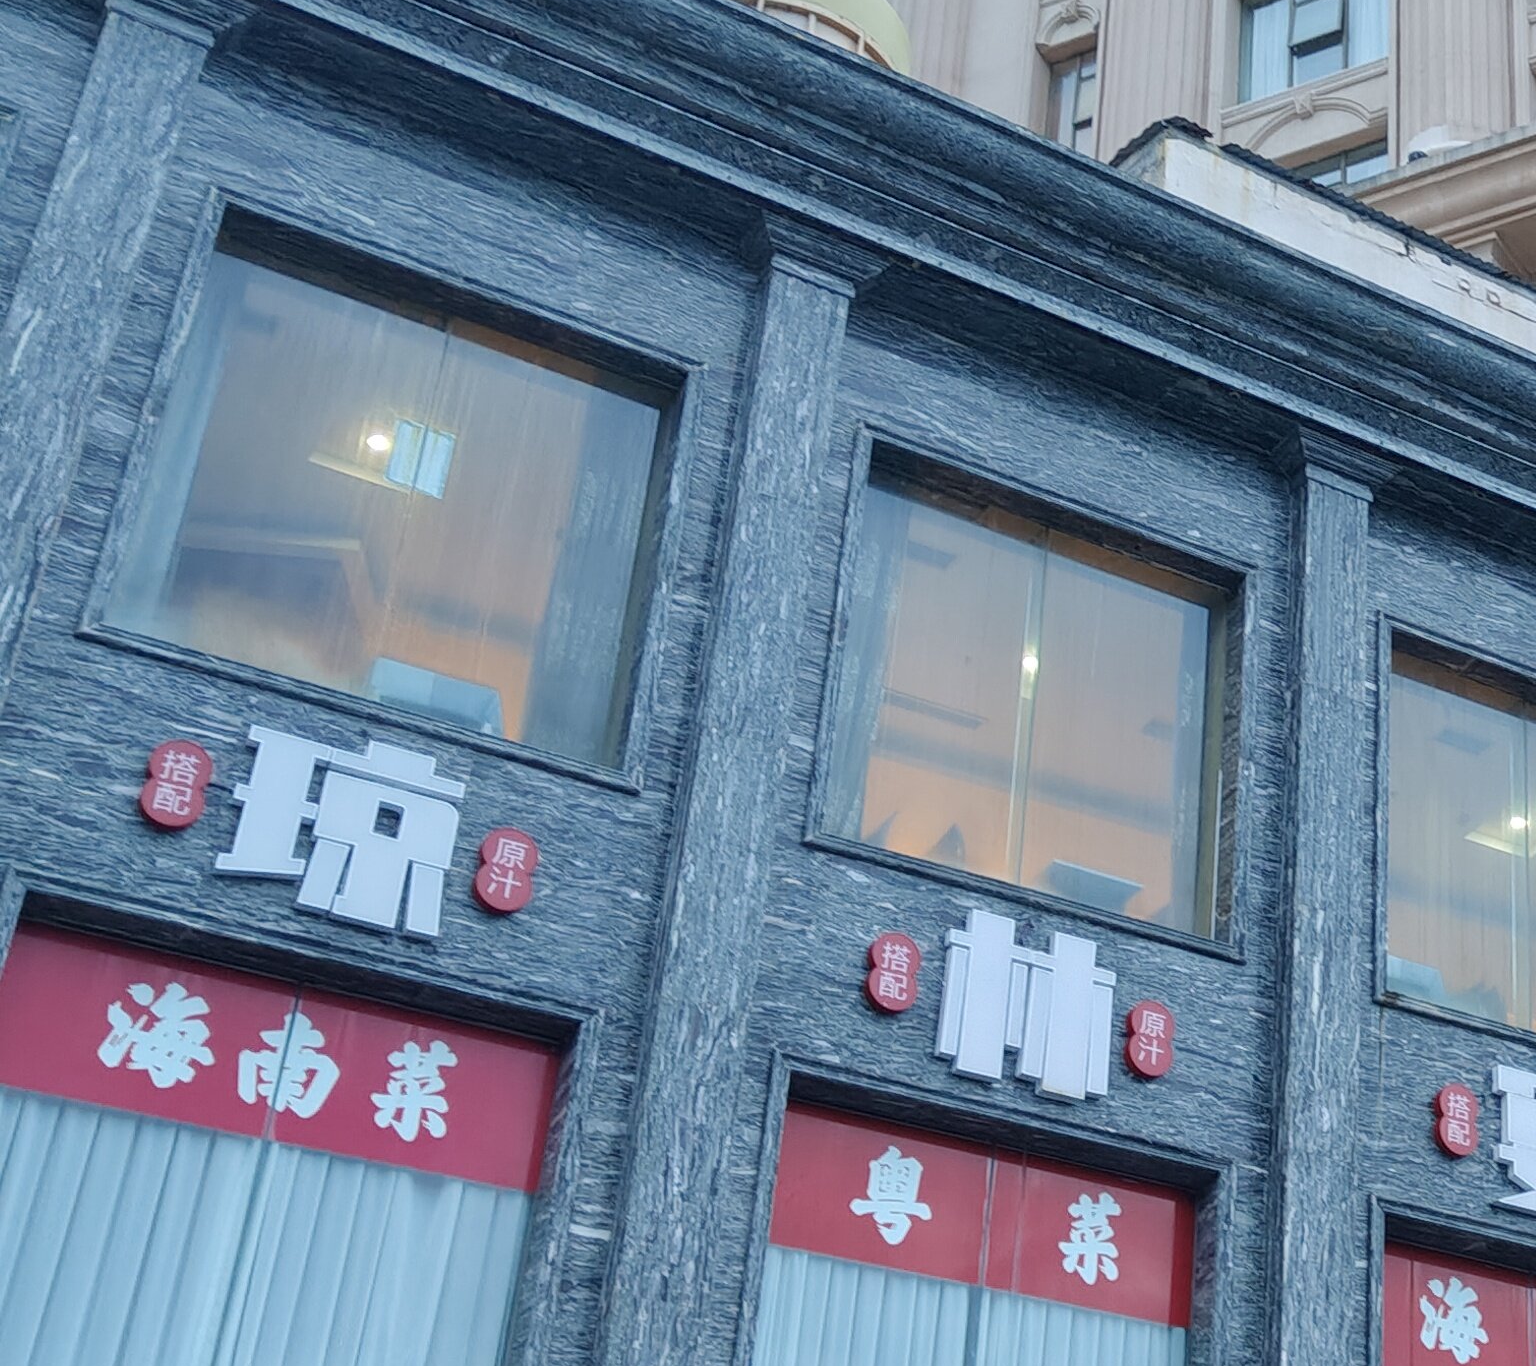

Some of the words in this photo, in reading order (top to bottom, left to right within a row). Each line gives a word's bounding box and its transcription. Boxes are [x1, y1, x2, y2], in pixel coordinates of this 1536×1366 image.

[148, 748, 199, 817] 搭配
[215, 724, 467, 938] 琼
[486, 836, 530, 900] 原汁
[878, 942, 911, 1002] 搭配
[934, 908, 1117, 1101] 林
[97, 980, 458, 1143] 海南菜
[1135, 1010, 1167, 1066] 原汁
[1446, 1091, 1472, 1147] 搭配
[848, 1145, 1123, 1287] 粤菜
